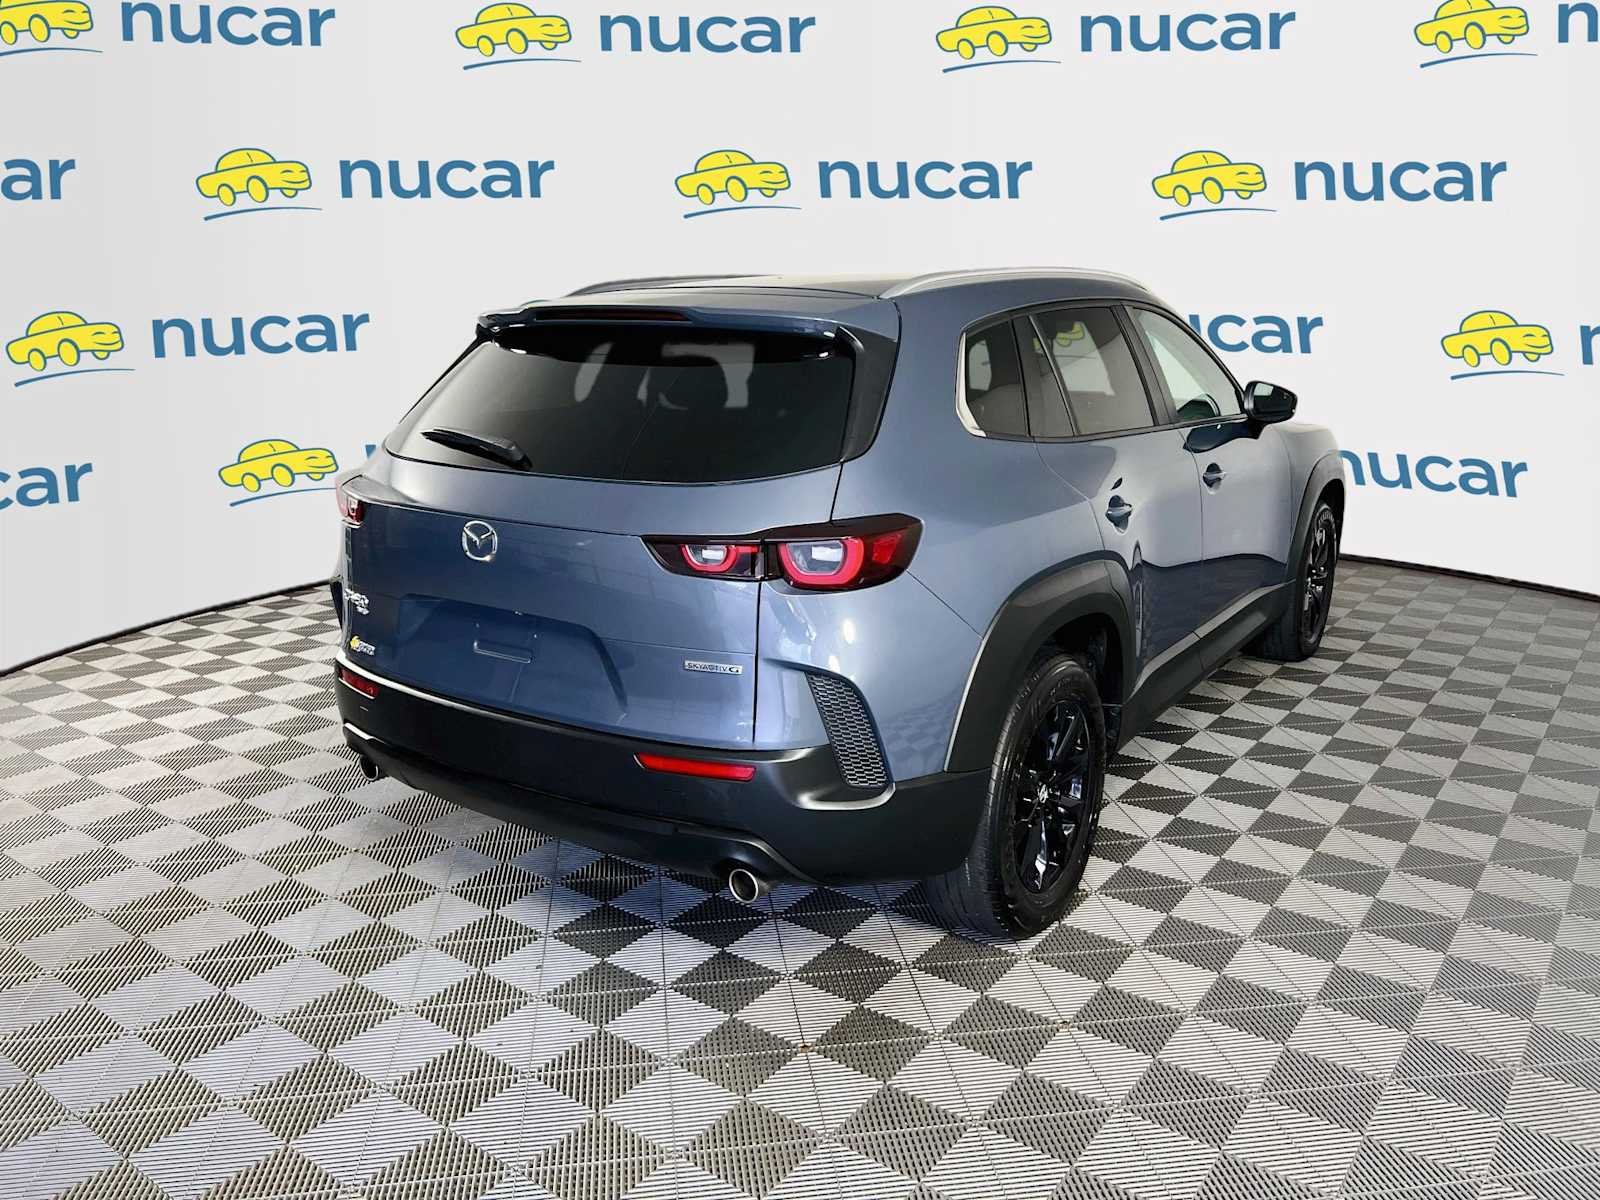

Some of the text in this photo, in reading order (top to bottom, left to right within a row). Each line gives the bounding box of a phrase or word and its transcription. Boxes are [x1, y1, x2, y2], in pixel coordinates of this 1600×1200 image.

[121, 1, 336, 46] nucar
[599, 15, 817, 54] nucar
[1080, 11, 1297, 53] nucar
[0, 159, 75, 201] ar
[339, 159, 555, 199] nucar
[819, 160, 1033, 199] nucar
[1295, 160, 1507, 202] nucar
[152, 313, 369, 359] nucar
[1189, 314, 1324, 354] car
